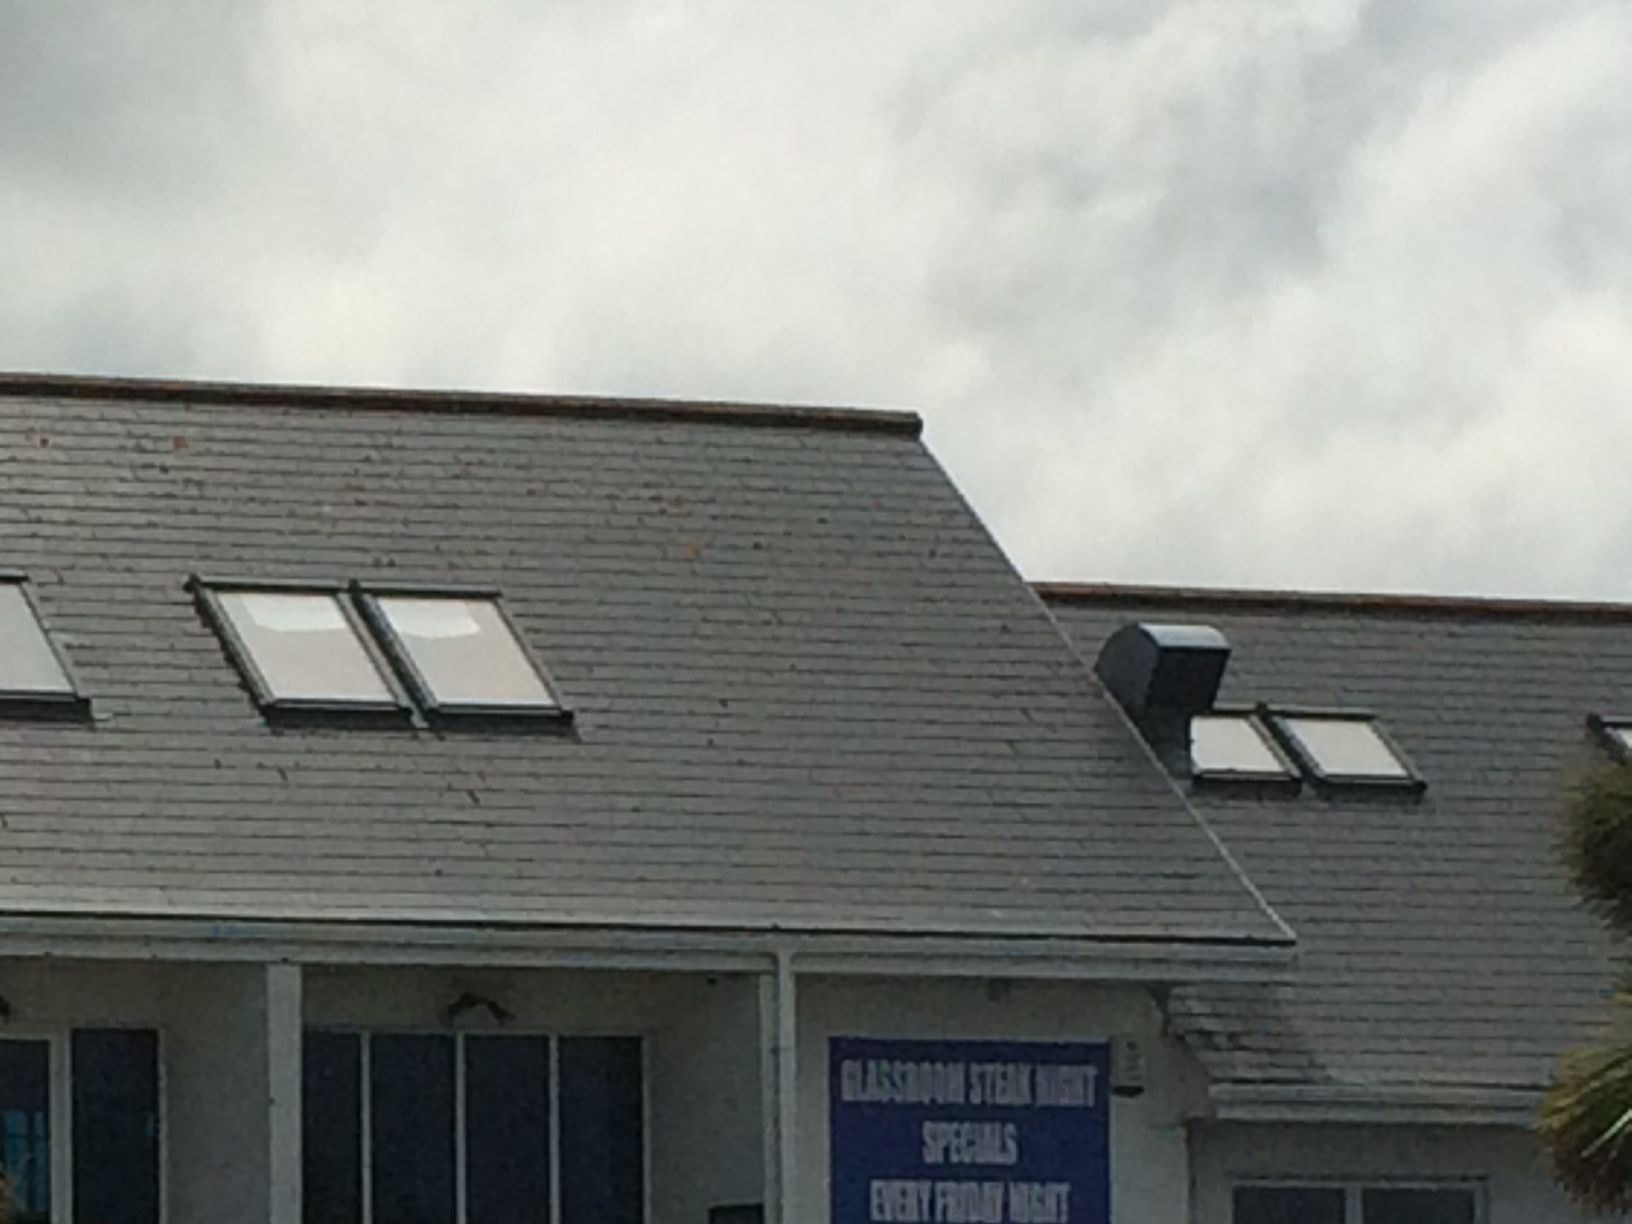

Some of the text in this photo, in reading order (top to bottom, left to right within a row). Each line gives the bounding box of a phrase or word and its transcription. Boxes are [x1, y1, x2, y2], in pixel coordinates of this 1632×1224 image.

[969, 1062, 1032, 1106] STEAK
[1034, 1064, 1098, 1107] NIGHT
[922, 1121, 1018, 1164] SPECIALS
[870, 1178, 1071, 1224] EVERY FRIDAY NIGHT
